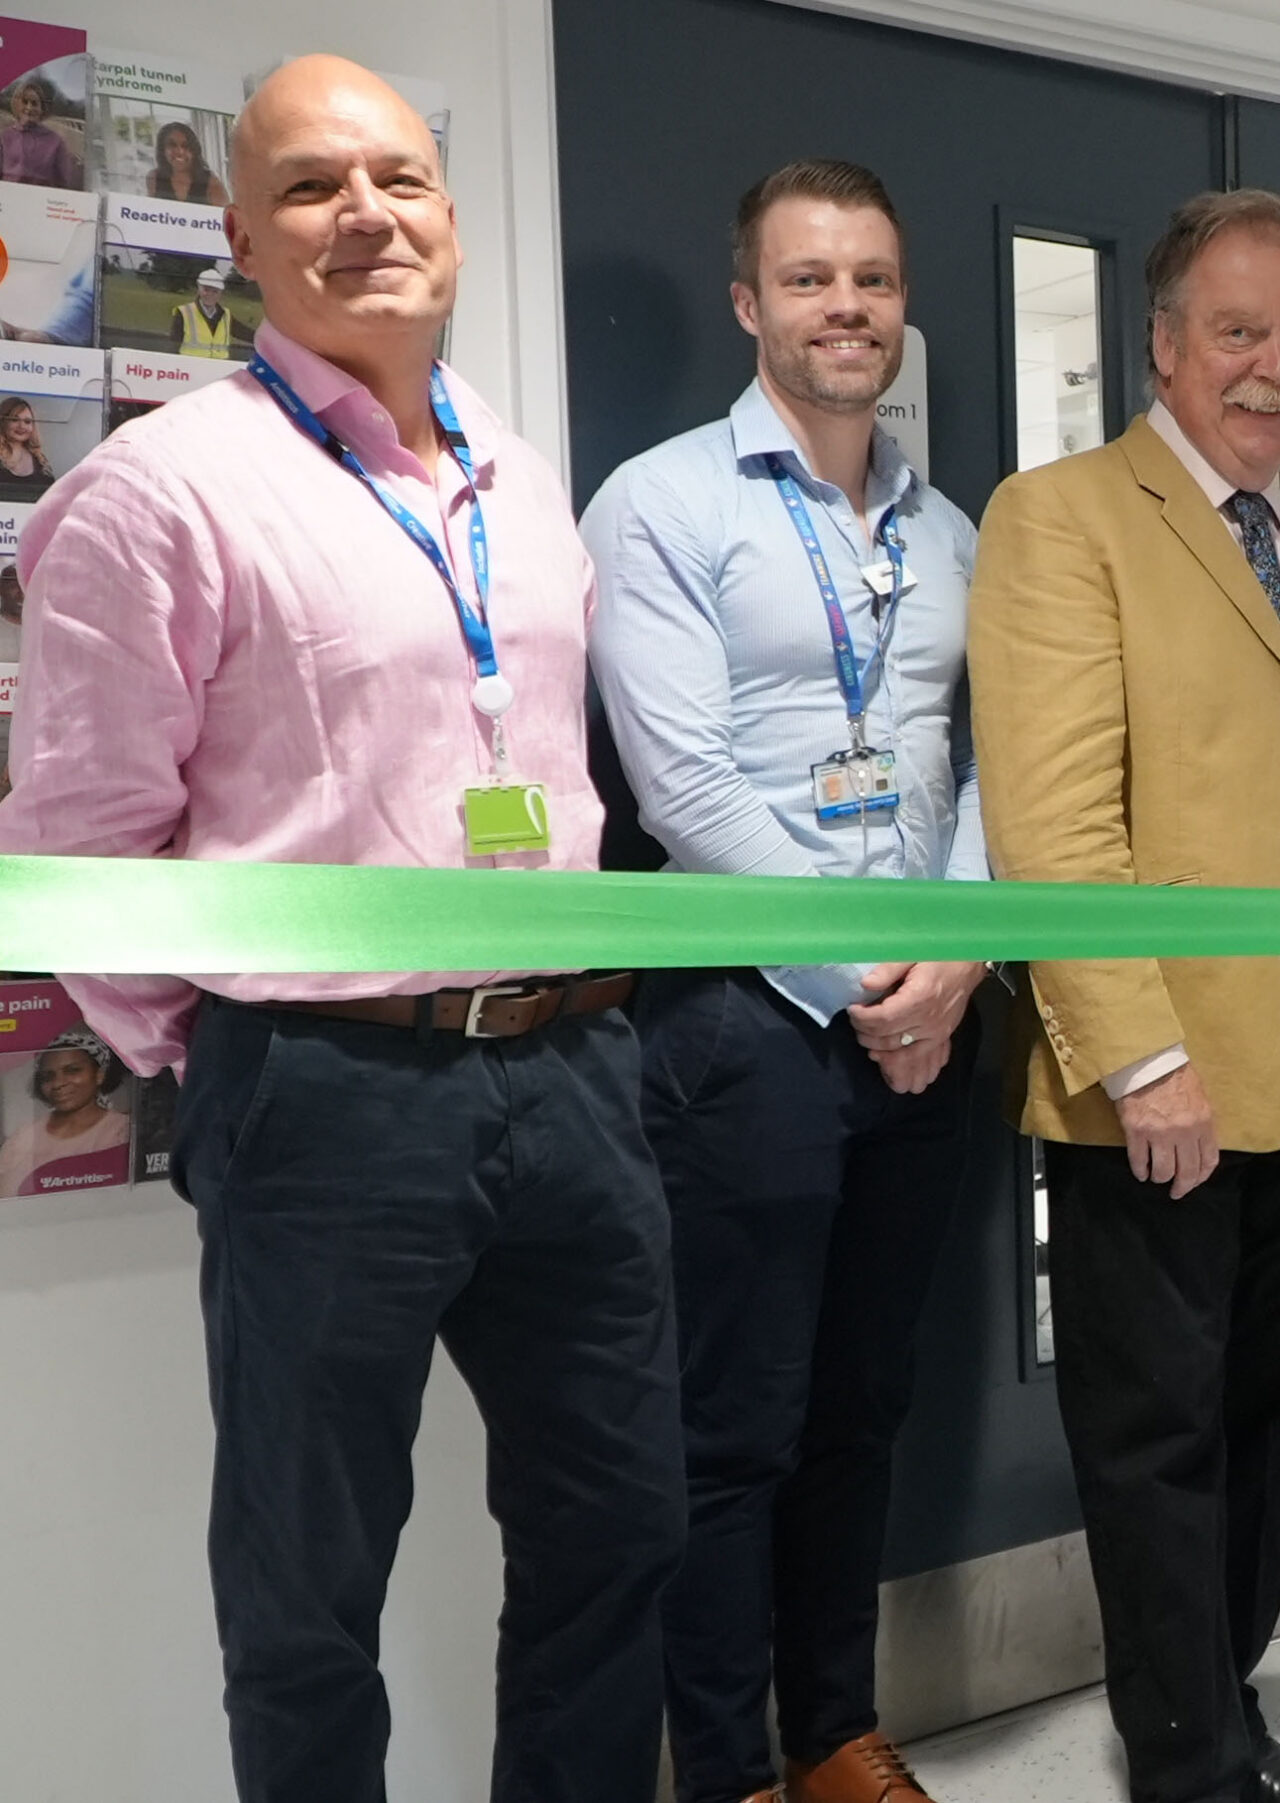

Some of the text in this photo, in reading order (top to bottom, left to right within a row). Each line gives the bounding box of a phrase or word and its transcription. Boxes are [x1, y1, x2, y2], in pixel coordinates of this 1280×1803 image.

[94, 75, 162, 93] yndrome
[140, 67, 186, 84] tunnel
[120, 206, 224, 231] Reactive arth
[2, 360, 80, 379] ankle pain
[126, 364, 190, 381] Hip pain
[406, 520, 433, 552] Creative
[9, 996, 51, 1014] pain
